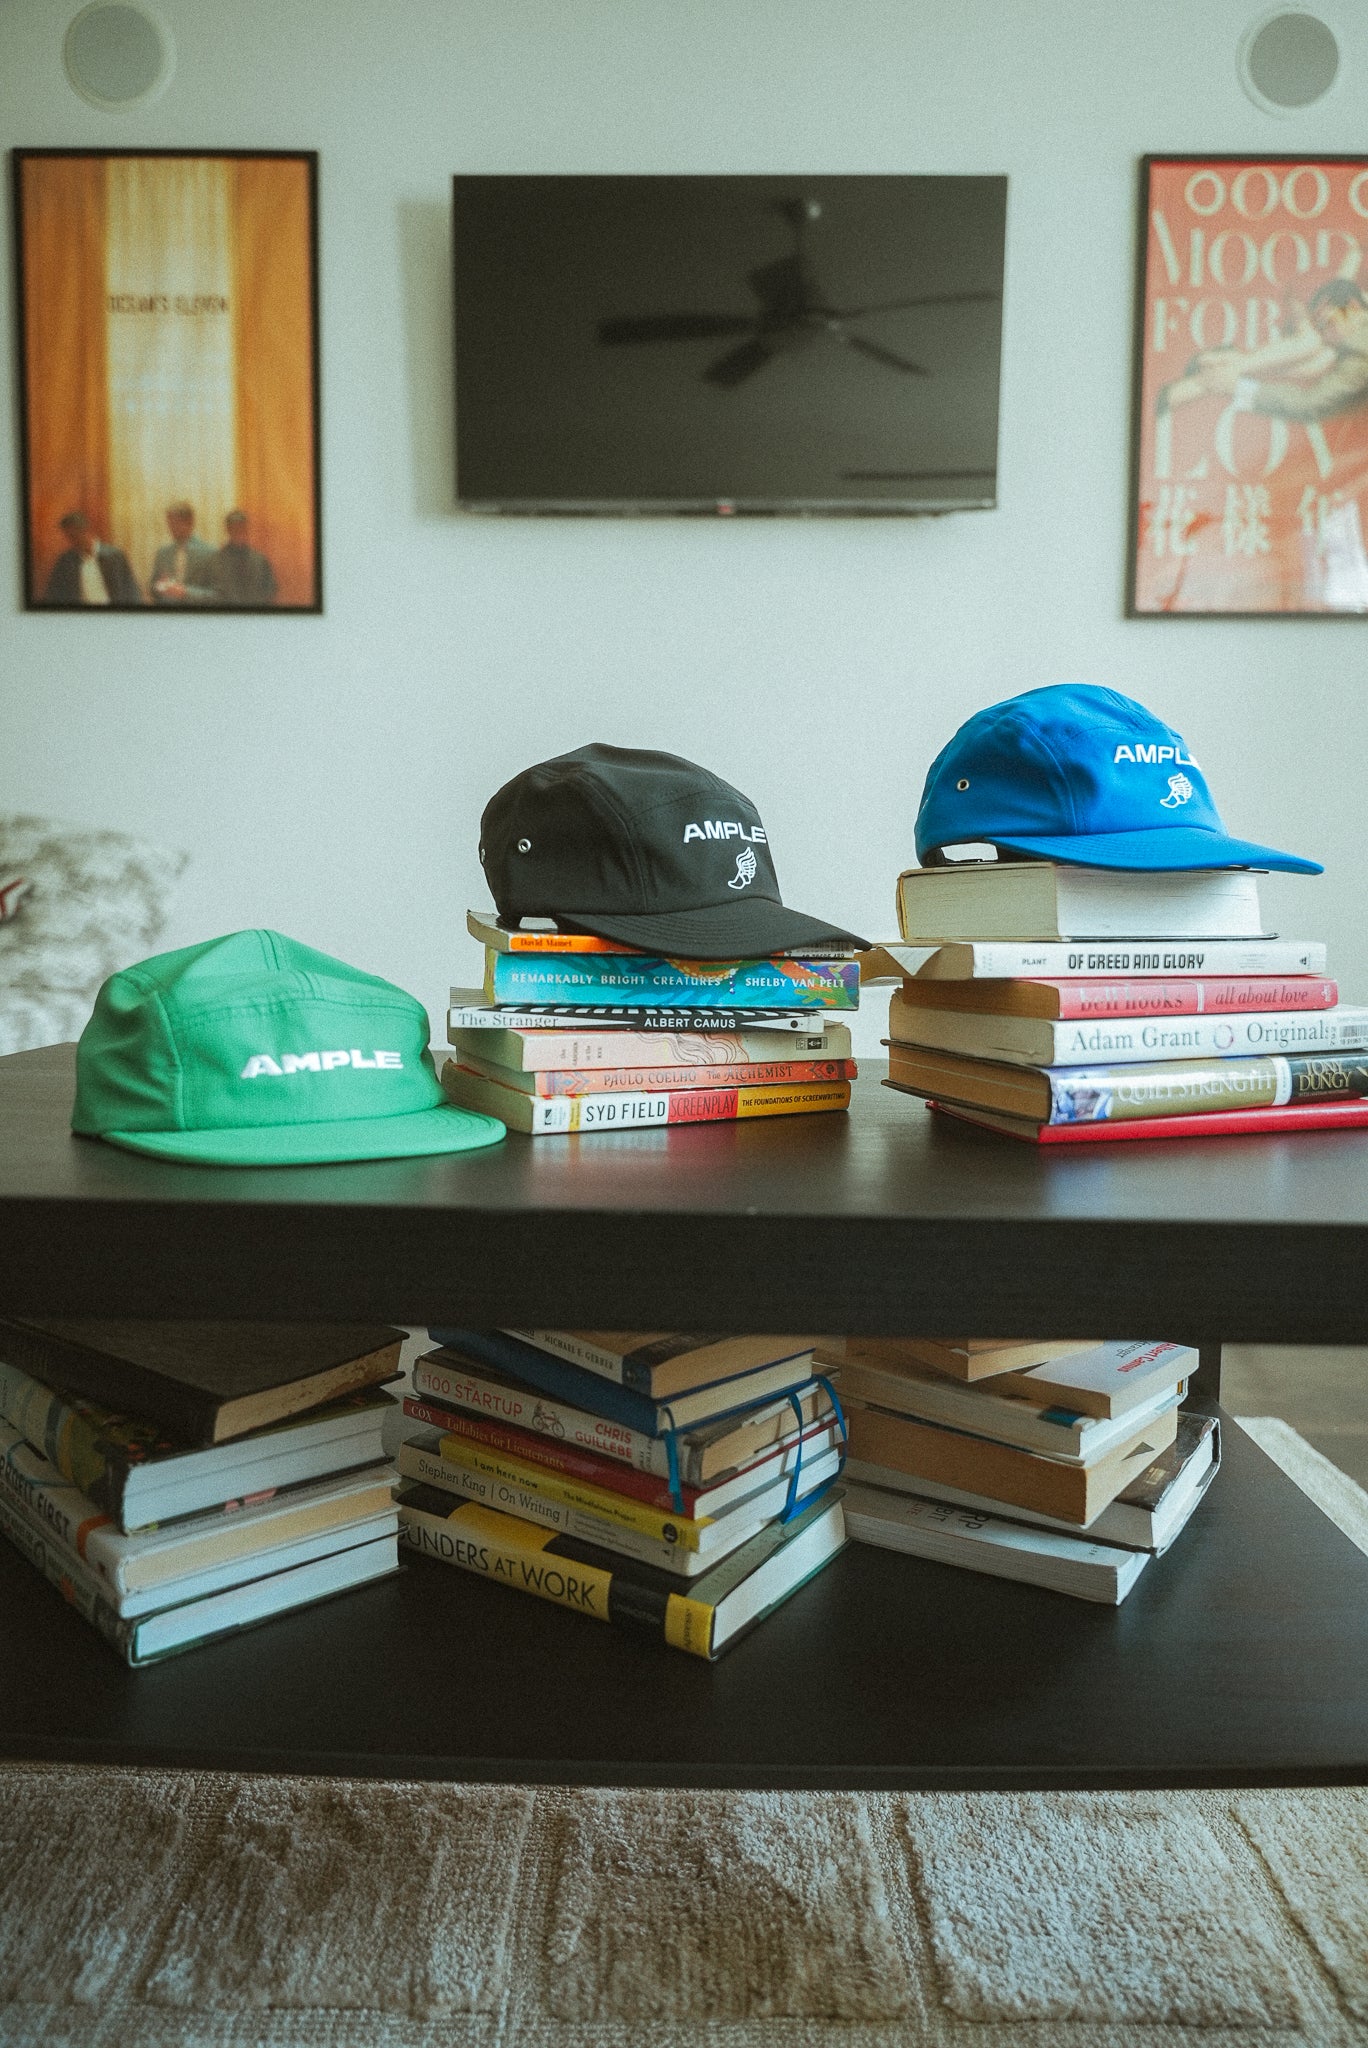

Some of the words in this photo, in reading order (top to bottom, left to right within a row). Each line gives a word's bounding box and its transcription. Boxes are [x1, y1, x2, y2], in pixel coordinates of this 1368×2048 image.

[683, 820, 767, 844] AMPLE
[520, 938, 543, 947] David
[1021, 958, 1047, 966] PLANT
[1068, 954, 1084, 969] OF
[1088, 954, 1130, 969] GREED
[1133, 954, 1159, 969] AND
[1163, 954, 1205, 969] GLORY
[511, 973, 594, 985] REMARKABLY
[601, 975, 646, 985] BRIGHT
[653, 975, 721, 986] CREATURES
[745, 977, 788, 988] SHELBY
[792, 977, 815, 988] VAN
[819, 977, 845, 988] PELT
[1080, 986, 1119, 1011] bell
[1123, 984, 1184, 1010] hooks
[1215, 986, 1235, 1005] all
[1237, 984, 1279, 1004] about
[1280, 985, 1309, 1003] love
[458, 1013, 487, 1026] The
[492, 1013, 559, 1028] Stranger
[643, 1017, 690, 1029] ALBERT
[694, 1018, 736, 1029] CAMUS
[1071, 1028, 1133, 1051] Adam
[1142, 1025, 1201, 1048] Grant
[240, 1049, 404, 1079] AMPLE
[707, 1070, 721, 1080] The
[724, 1065, 794, 1082] ALCHEMIST
[1305, 1060, 1344, 1075] TONY
[604, 1074, 644, 1088] PAULO
[648, 1070, 697, 1085] COELHO
[1299, 1071, 1352, 1091] DUNGY
[670, 1094, 737, 1118] SCREENPLAY
[742, 1099, 753, 1107] THE
[754, 1096, 793, 1106] FOUNDATIONS
[794, 1095, 802, 1103] OF
[802, 1091, 846, 1103] SCREENWRITING
[586, 1104, 617, 1122] SYD
[621, 1101, 667, 1120] FIELD
[544, 1334, 576, 1355] MICHAEL
[585, 1351, 614, 1371] GERBER
[422, 1374, 451, 1394] $100
[455, 1384, 523, 1418] STARTUP
[411, 1404, 433, 1422] COX
[446, 1416, 490, 1441] Lullabies
[490, 1433, 505, 1446] for
[507, 1439, 565, 1469] Lieutenants
[595, 1423, 632, 1444] CHRIS
[575, 1430, 633, 1459] GUILLEBE
[479, 1462, 494, 1473] am
[496, 1466, 517, 1483] here
[519, 1477, 538, 1489] now
[418, 1459, 459, 1485] Stephen
[462, 1473, 487, 1496] King
[498, 1487, 517, 1505] On
[519, 1493, 561, 1523] Writing
[401, 1523, 489, 1572] UNDERS
[494, 1556, 516, 1578] AT
[521, 1560, 596, 1611] WORK
